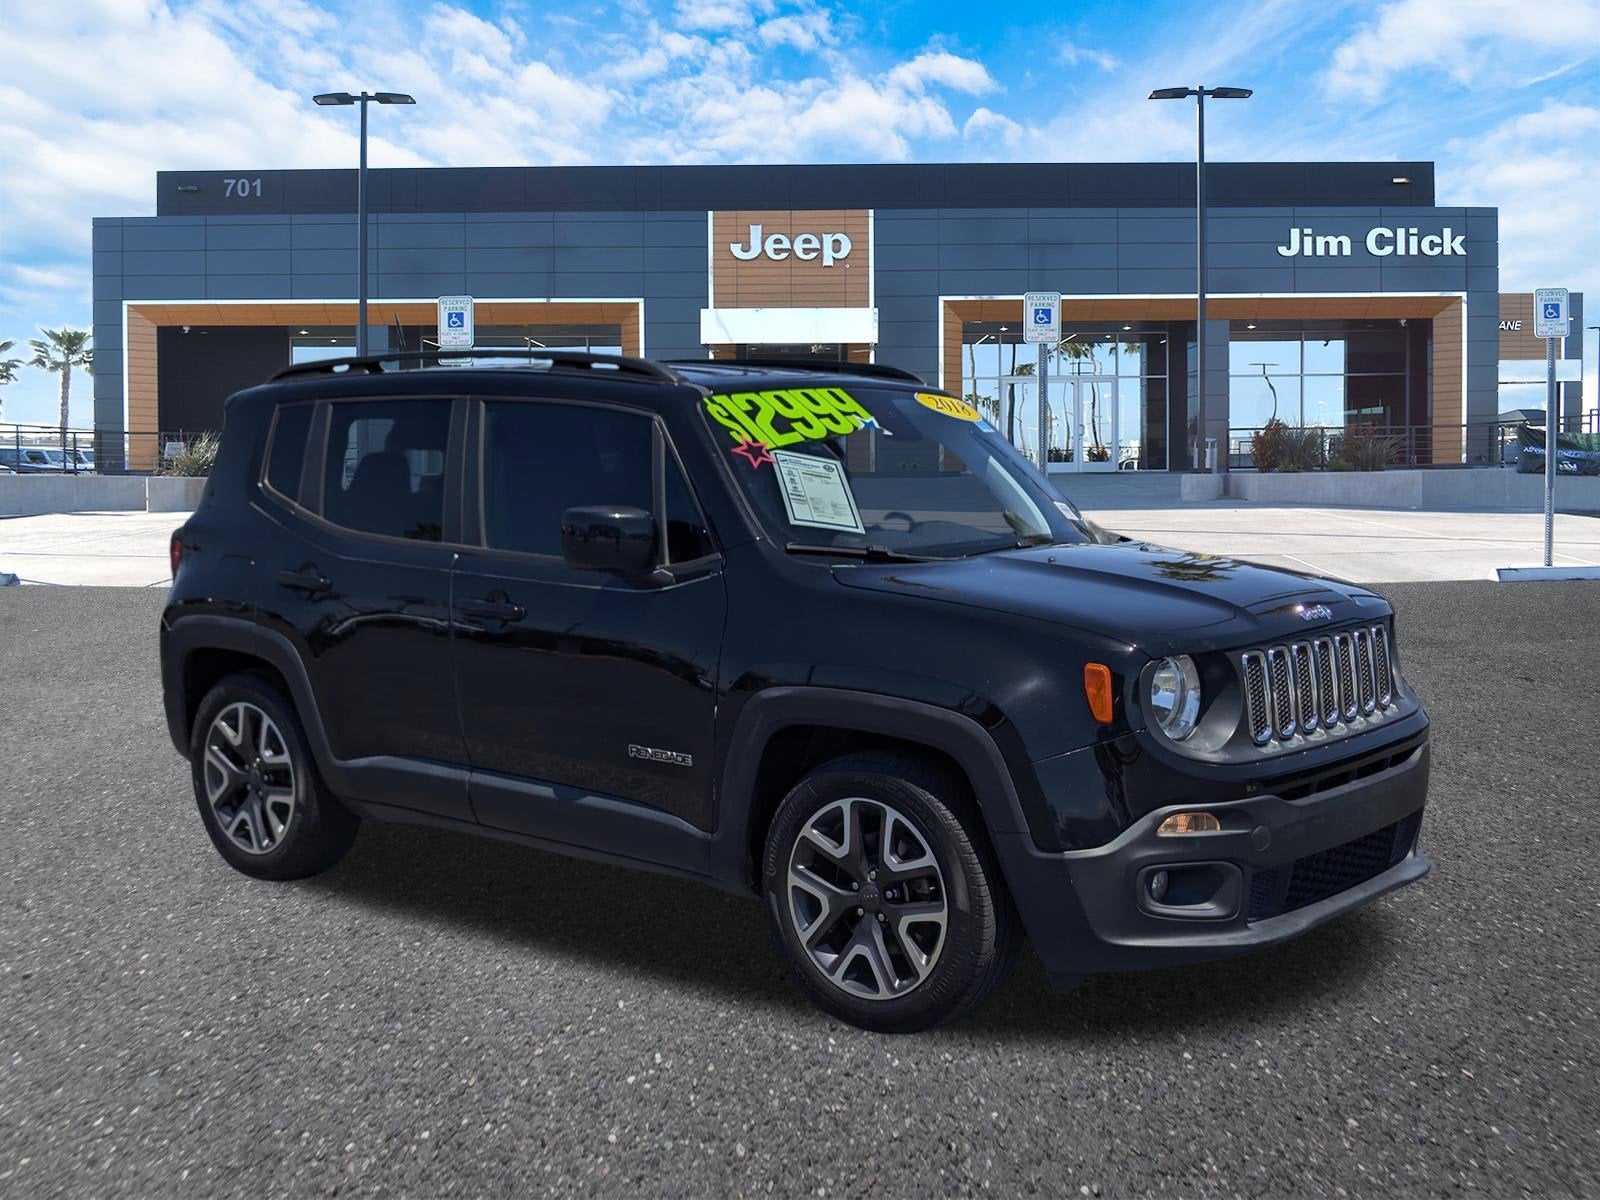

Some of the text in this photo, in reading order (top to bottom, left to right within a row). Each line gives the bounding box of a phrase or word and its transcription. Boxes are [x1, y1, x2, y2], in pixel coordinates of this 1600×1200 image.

[223, 178, 262, 198] 701
[729, 223, 853, 267] Jeep
[1277, 226, 1467, 257] Jim Click
[703, 387, 876, 450] $12999
[927, 395, 973, 418] 2018
[628, 744, 693, 767] RENEGADE
